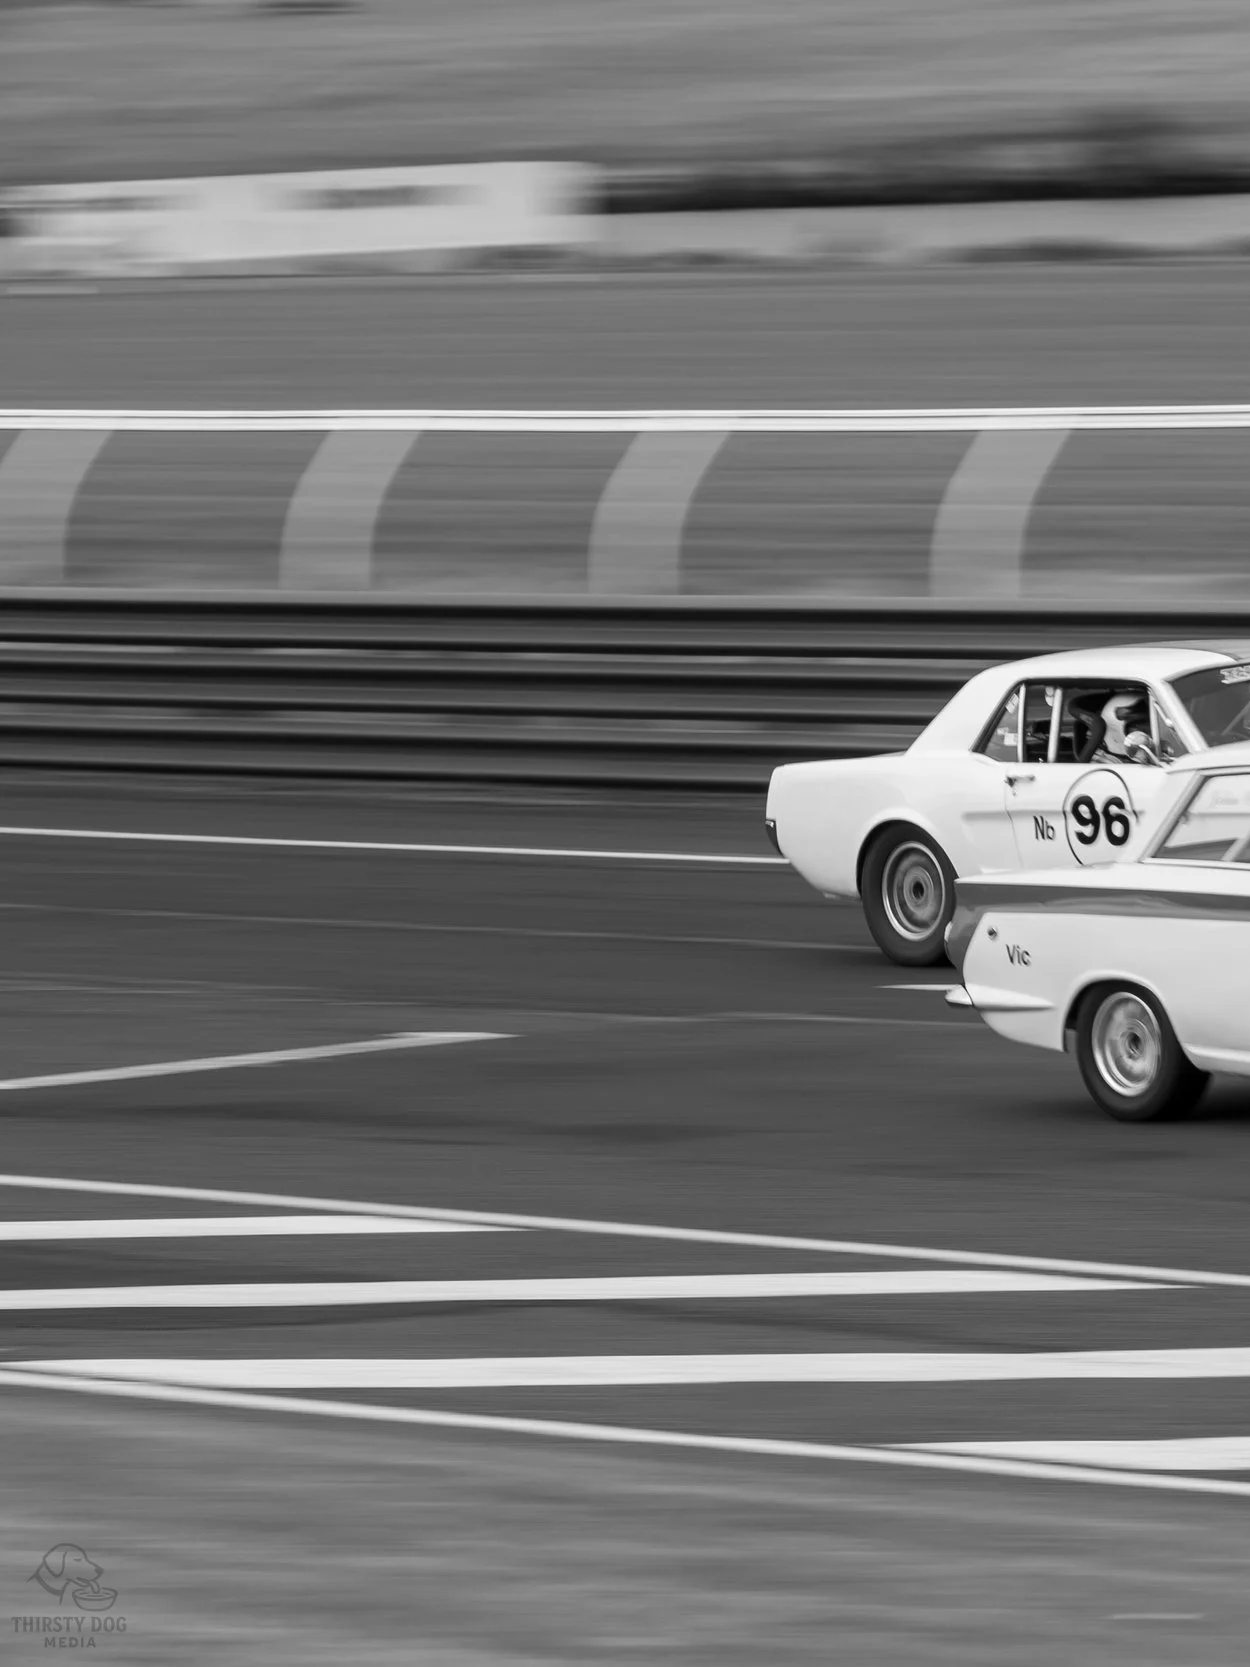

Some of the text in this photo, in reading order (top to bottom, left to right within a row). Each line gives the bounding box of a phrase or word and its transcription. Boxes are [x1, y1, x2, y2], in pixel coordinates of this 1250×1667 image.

[1033, 794, 1131, 846] Nb 96
[1005, 943, 1032, 967] Vic
